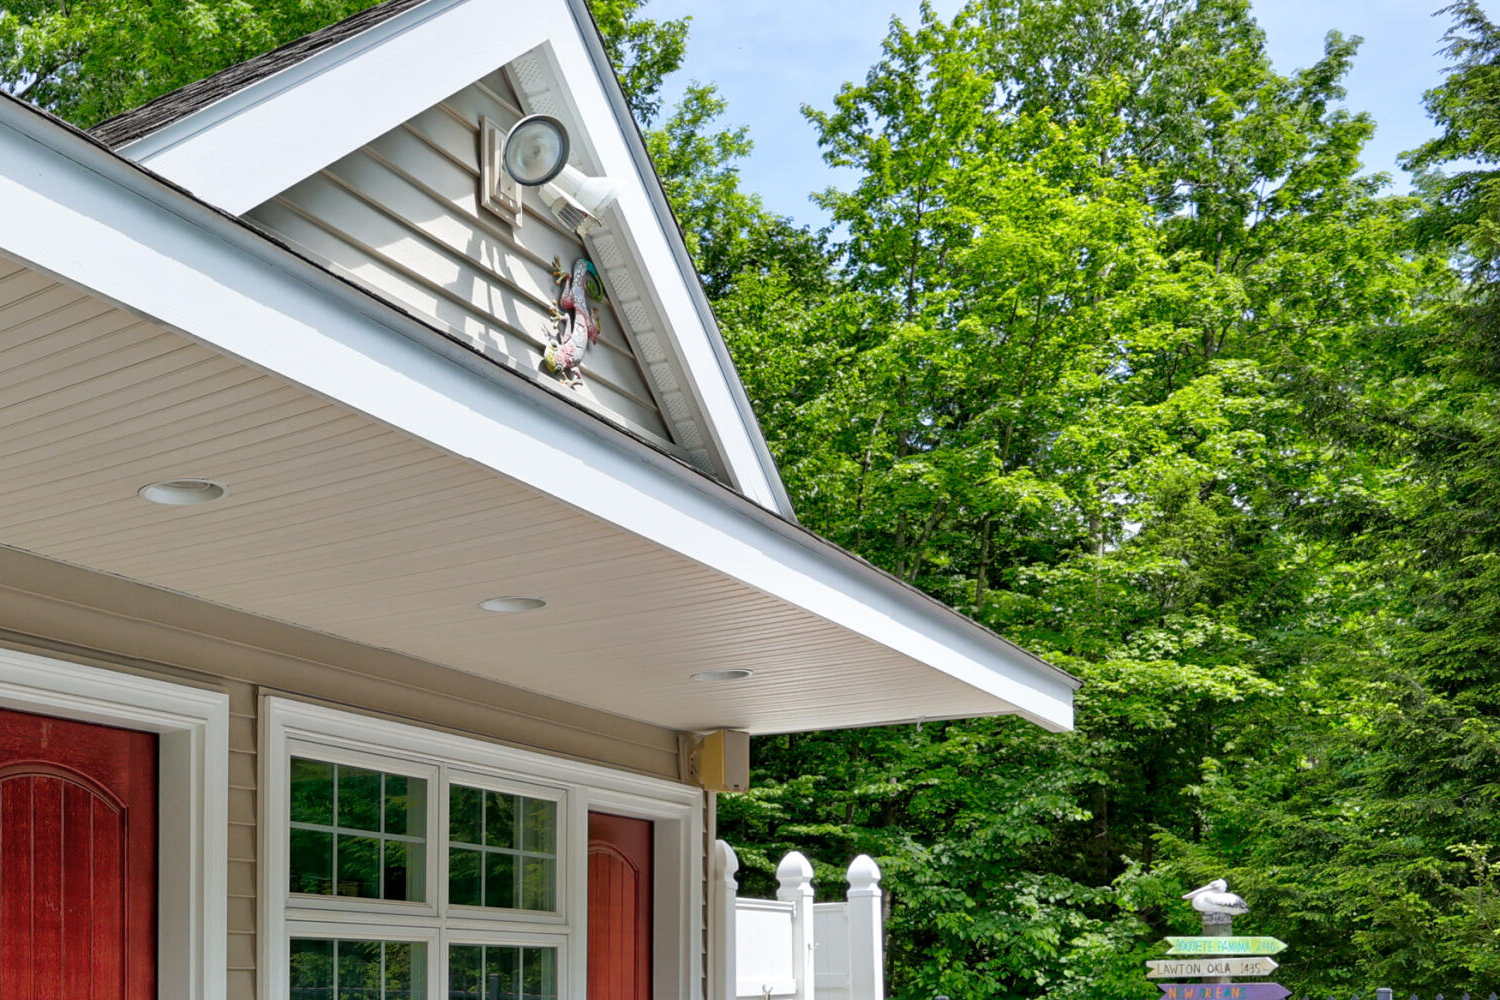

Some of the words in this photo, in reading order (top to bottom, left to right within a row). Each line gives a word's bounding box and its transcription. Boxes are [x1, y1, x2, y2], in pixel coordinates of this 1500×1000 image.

[1207, 962, 1230, 974] OKLA
[1168, 986, 1194, 1000] NEW
[1198, 986, 1247, 1000] ORLEANS
